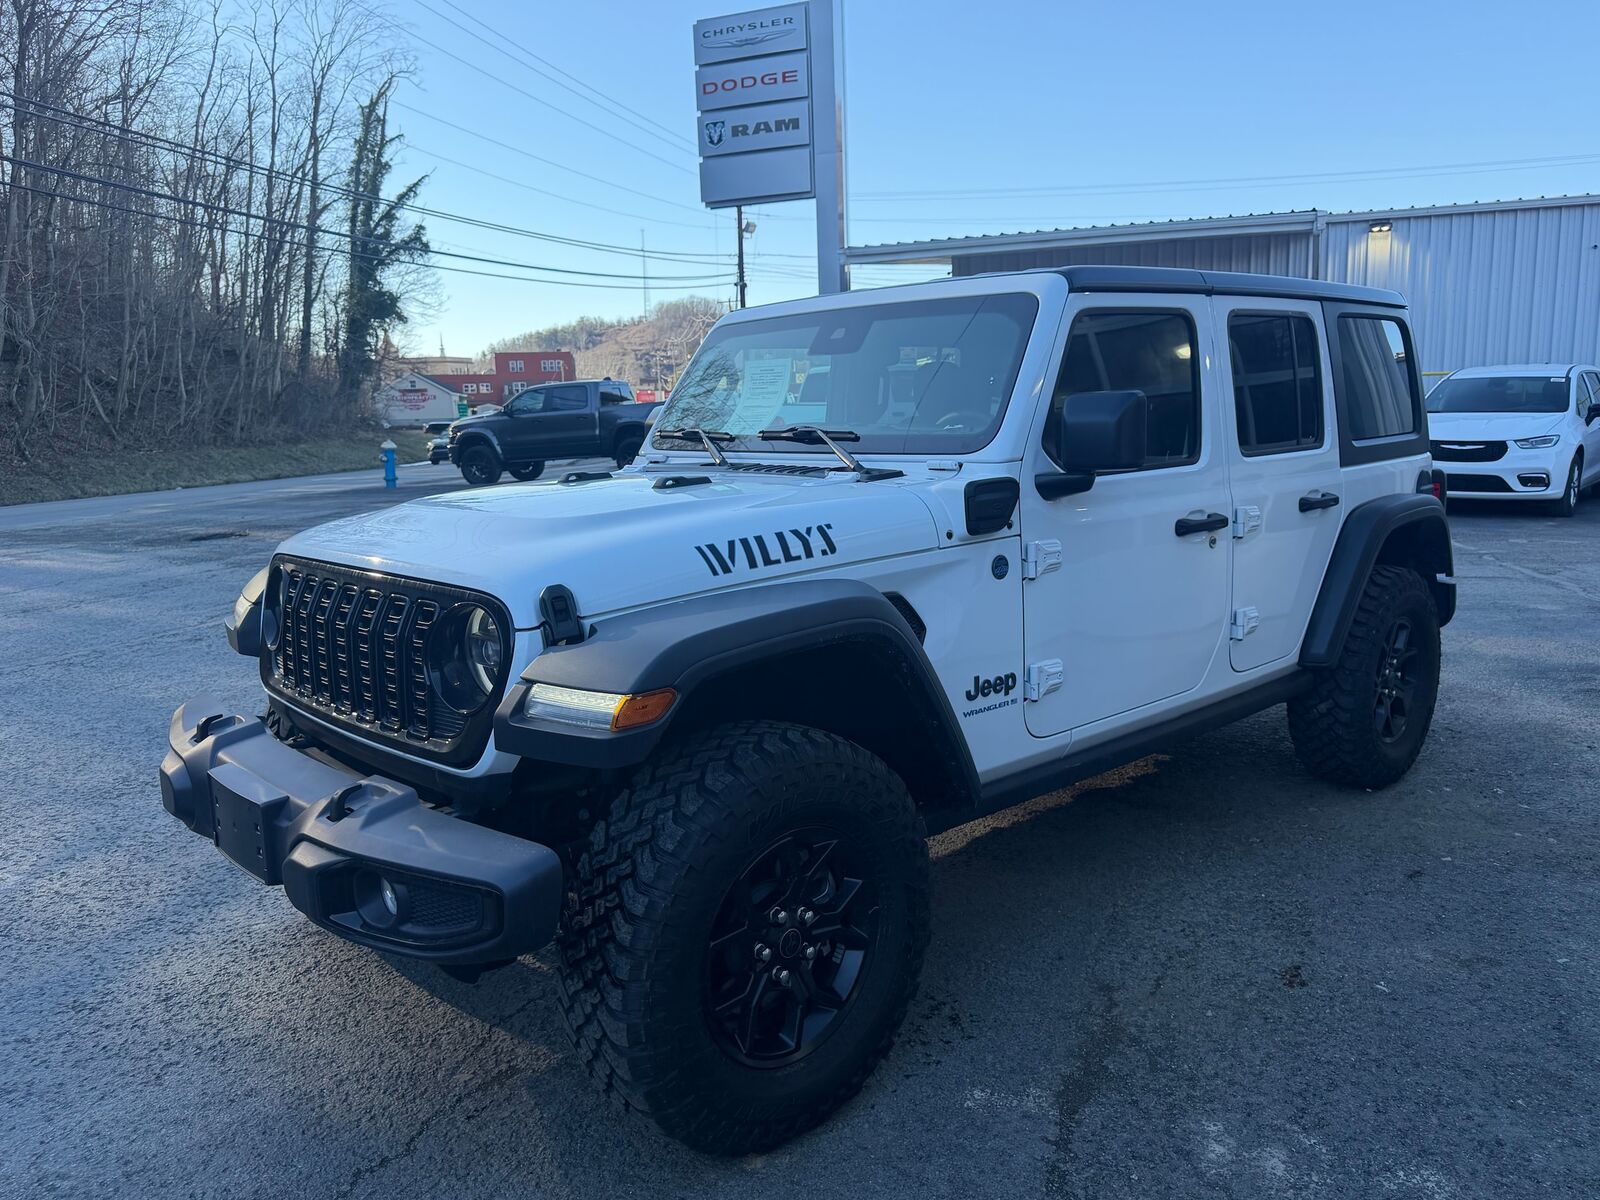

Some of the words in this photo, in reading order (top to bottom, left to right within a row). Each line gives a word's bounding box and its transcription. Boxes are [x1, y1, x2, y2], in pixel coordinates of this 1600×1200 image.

[702, 16, 794, 39] CHRYSLER
[703, 70, 798, 95] DODGE
[731, 117, 800, 138] RAM
[694, 523, 837, 577] WILLYS
[965, 672, 1017, 701] Jeep
[963, 700, 1010, 719] WRANGLER
